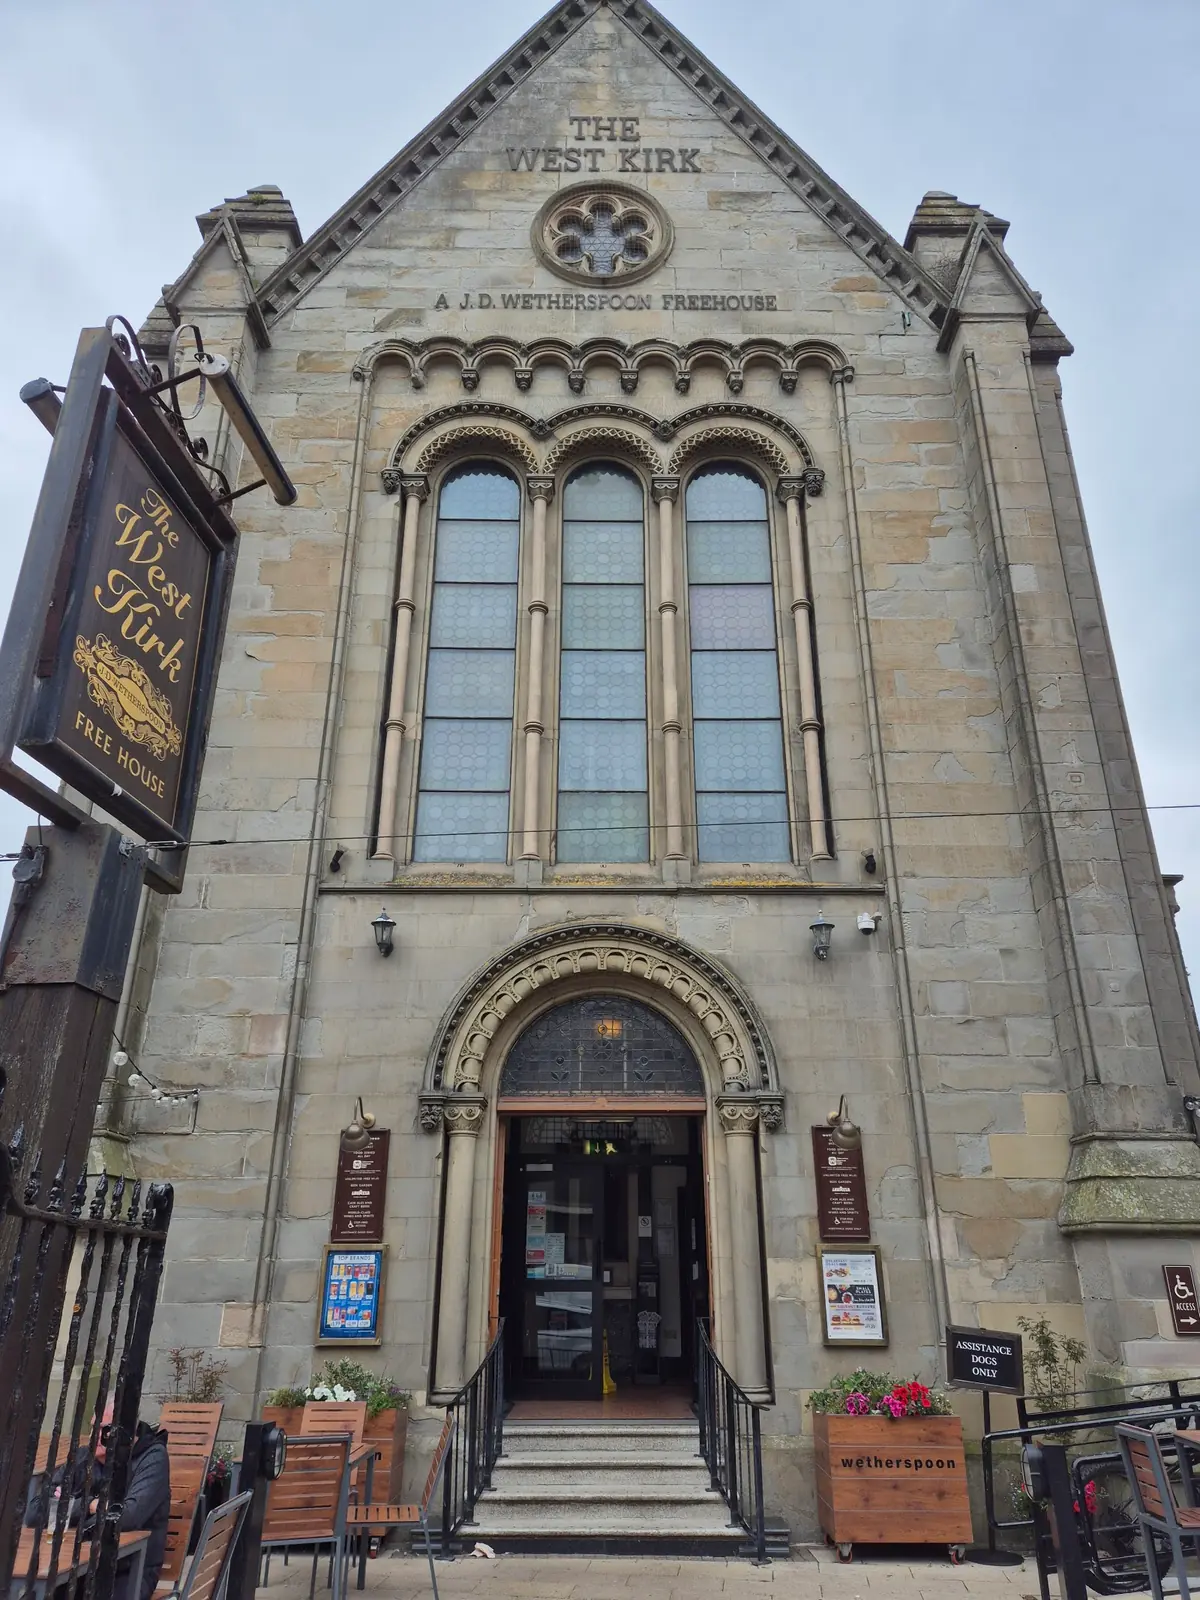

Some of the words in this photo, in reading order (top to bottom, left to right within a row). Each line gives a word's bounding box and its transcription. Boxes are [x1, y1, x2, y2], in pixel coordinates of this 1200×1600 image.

[569, 116, 640, 141] THE
[505, 148, 605, 172] WEST
[618, 149, 701, 173] KIRK
[434, 294, 449, 312] A
[501, 293, 651, 311] WETHERSPOON
[662, 294, 778, 312] FREEHOUSE
[141, 488, 179, 548] The
[115, 503, 192, 620] West
[94, 569, 184, 683] Kirk
[75, 711, 113, 755] FREE
[117, 746, 165, 799] HOUSE
[956, 1341, 1012, 1356] ASSISTANCE
[971, 1354, 997, 1366] DOGS
[972, 1367, 998, 1378] ONLY
[841, 1456, 956, 1471] wetherspoon
